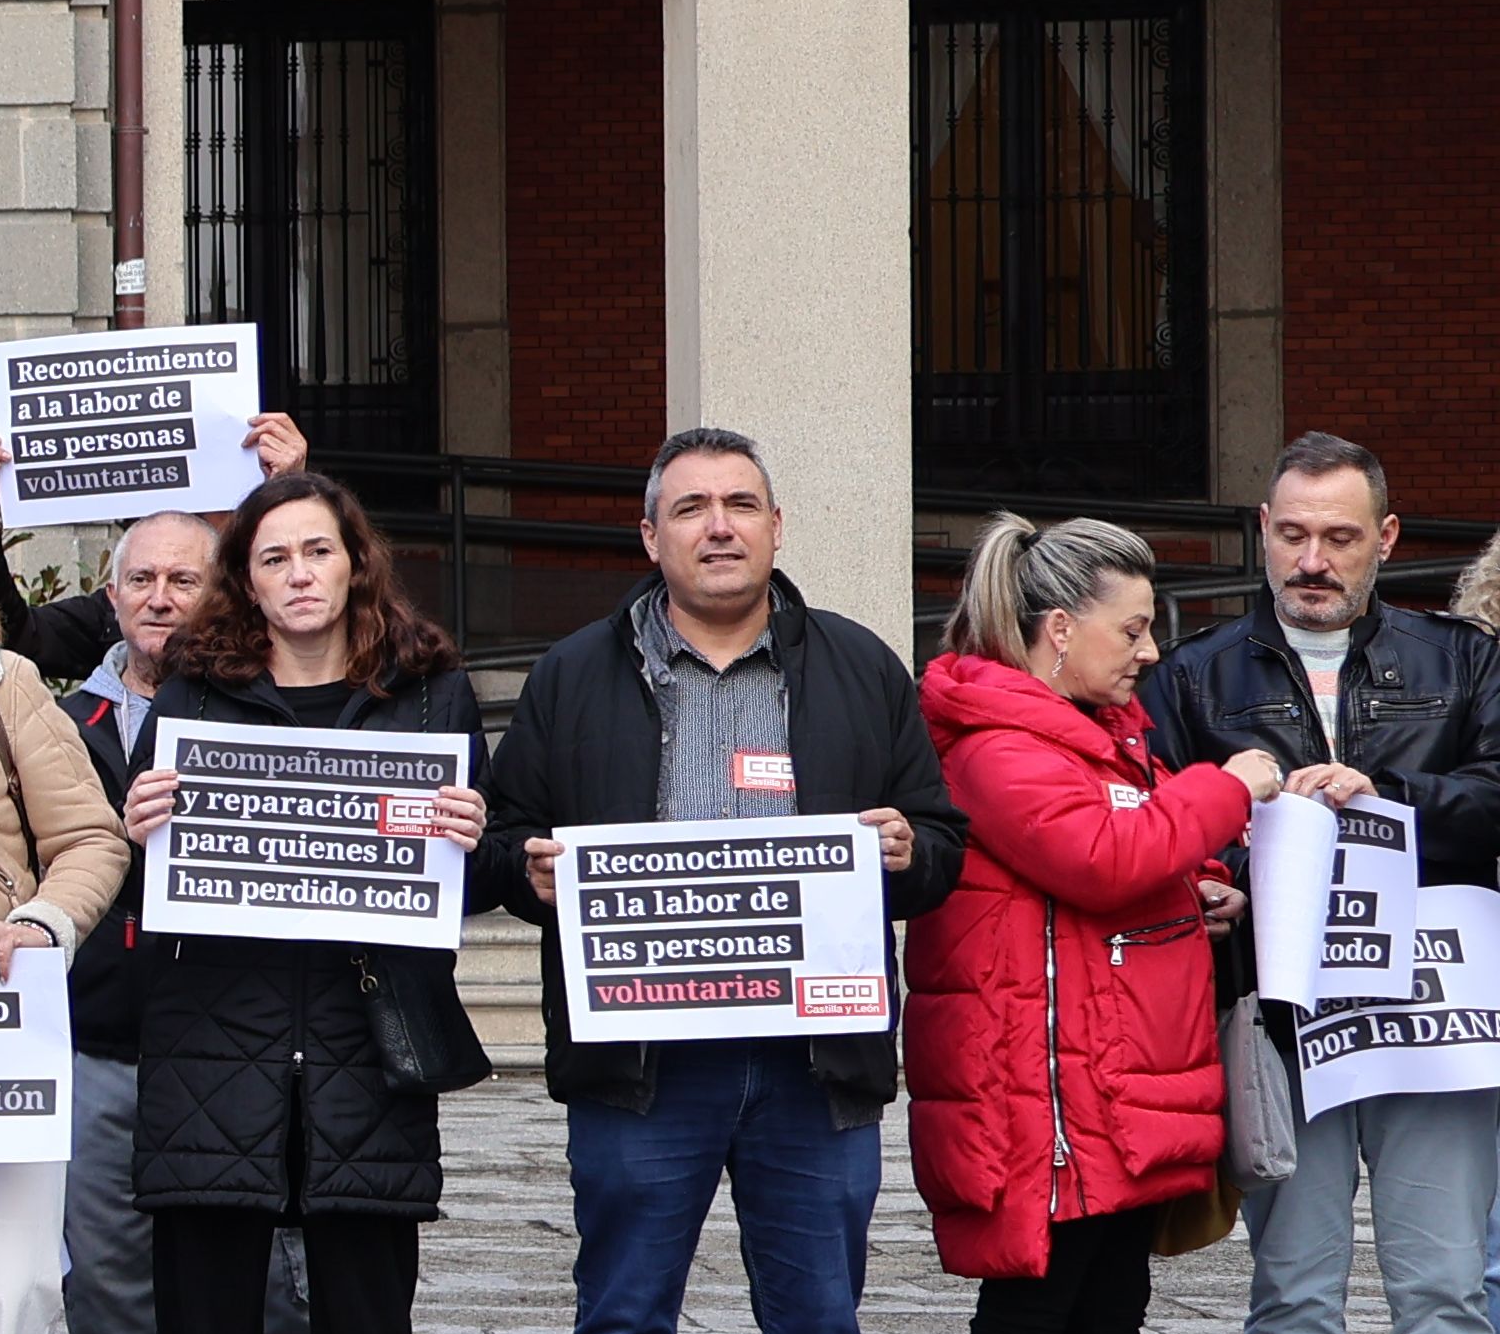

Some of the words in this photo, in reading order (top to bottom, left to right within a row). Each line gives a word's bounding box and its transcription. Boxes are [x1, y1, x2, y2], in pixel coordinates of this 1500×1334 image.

[17, 348, 233, 383] Reconocimiento
[17, 402, 32, 420] a
[38, 396, 63, 419] la
[69, 391, 142, 416] labor
[149, 386, 182, 408] de
[18, 435, 58, 458] las
[63, 427, 186, 460] personas
[24, 463, 179, 493] voluntarias
[183, 744, 444, 782] Acompañamiento
[750, 761, 794, 774] CCO
[743, 777, 780, 786] Castilla
[783, 781, 790, 789] y
[180, 790, 200, 815] y
[207, 790, 379, 821] reparación
[386, 824, 423, 834] Castilla
[425, 826, 432, 835] y
[179, 831, 250, 858] para
[258, 834, 378, 864] quienes
[386, 839, 415, 865] lo
[587, 842, 849, 876] Reconocimiento
[176, 871, 234, 899] han
[239, 879, 357, 906] perdido
[364, 886, 431, 912] todo
[589, 900, 608, 918] a
[615, 892, 646, 917] la
[654, 889, 741, 916] labor
[750, 886, 789, 911] de
[1336, 894, 1365, 918] lo
[591, 937, 637, 961] las
[645, 934, 791, 966] personas
[1322, 937, 1381, 962] todo
[1413, 932, 1452, 961] olo
[595, 974, 782, 1004] voluntarias
[810, 985, 872, 998] CCOO
[804, 1004, 843, 1014] Castilla
[844, 1007, 852, 1016] y
[854, 1004, 880, 1014] León
[1304, 1025, 1358, 1066] por
[1366, 1015, 1404, 1044] la
[1408, 1011, 1500, 1043] DAN
